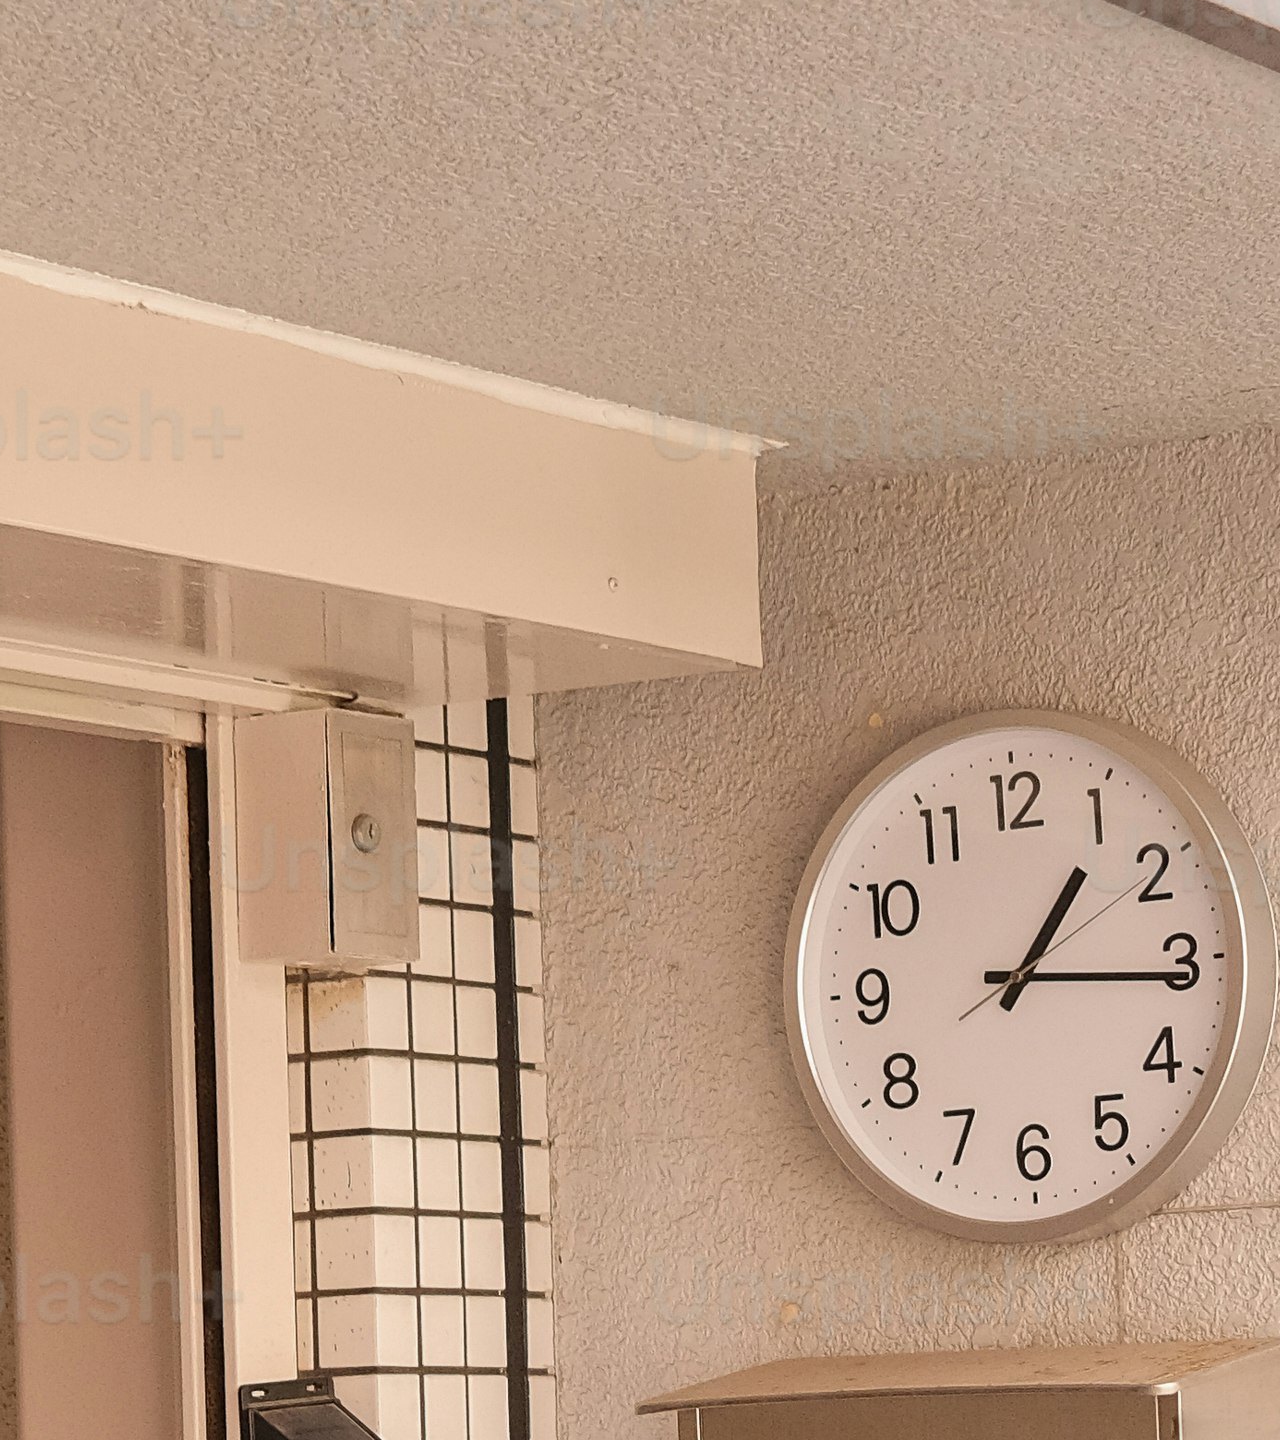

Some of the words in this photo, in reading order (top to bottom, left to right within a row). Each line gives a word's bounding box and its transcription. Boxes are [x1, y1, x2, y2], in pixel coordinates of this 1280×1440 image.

[990, 771, 1044, 831] 12
[1087, 788, 1103, 844] 1
[920, 807, 959, 864] 11
[1136, 844, 1173, 901] 2
[867, 880, 919, 938] 10
[1163, 933, 1199, 991] 3
[855, 969, 890, 1024] 9
[883, 1053, 919, 1109] 8
[1143, 1027, 1182, 1083] 4
[943, 1108, 975, 1165] 7
[1094, 1094, 1129, 1151] 5
[1016, 1124, 1052, 1181] 6
